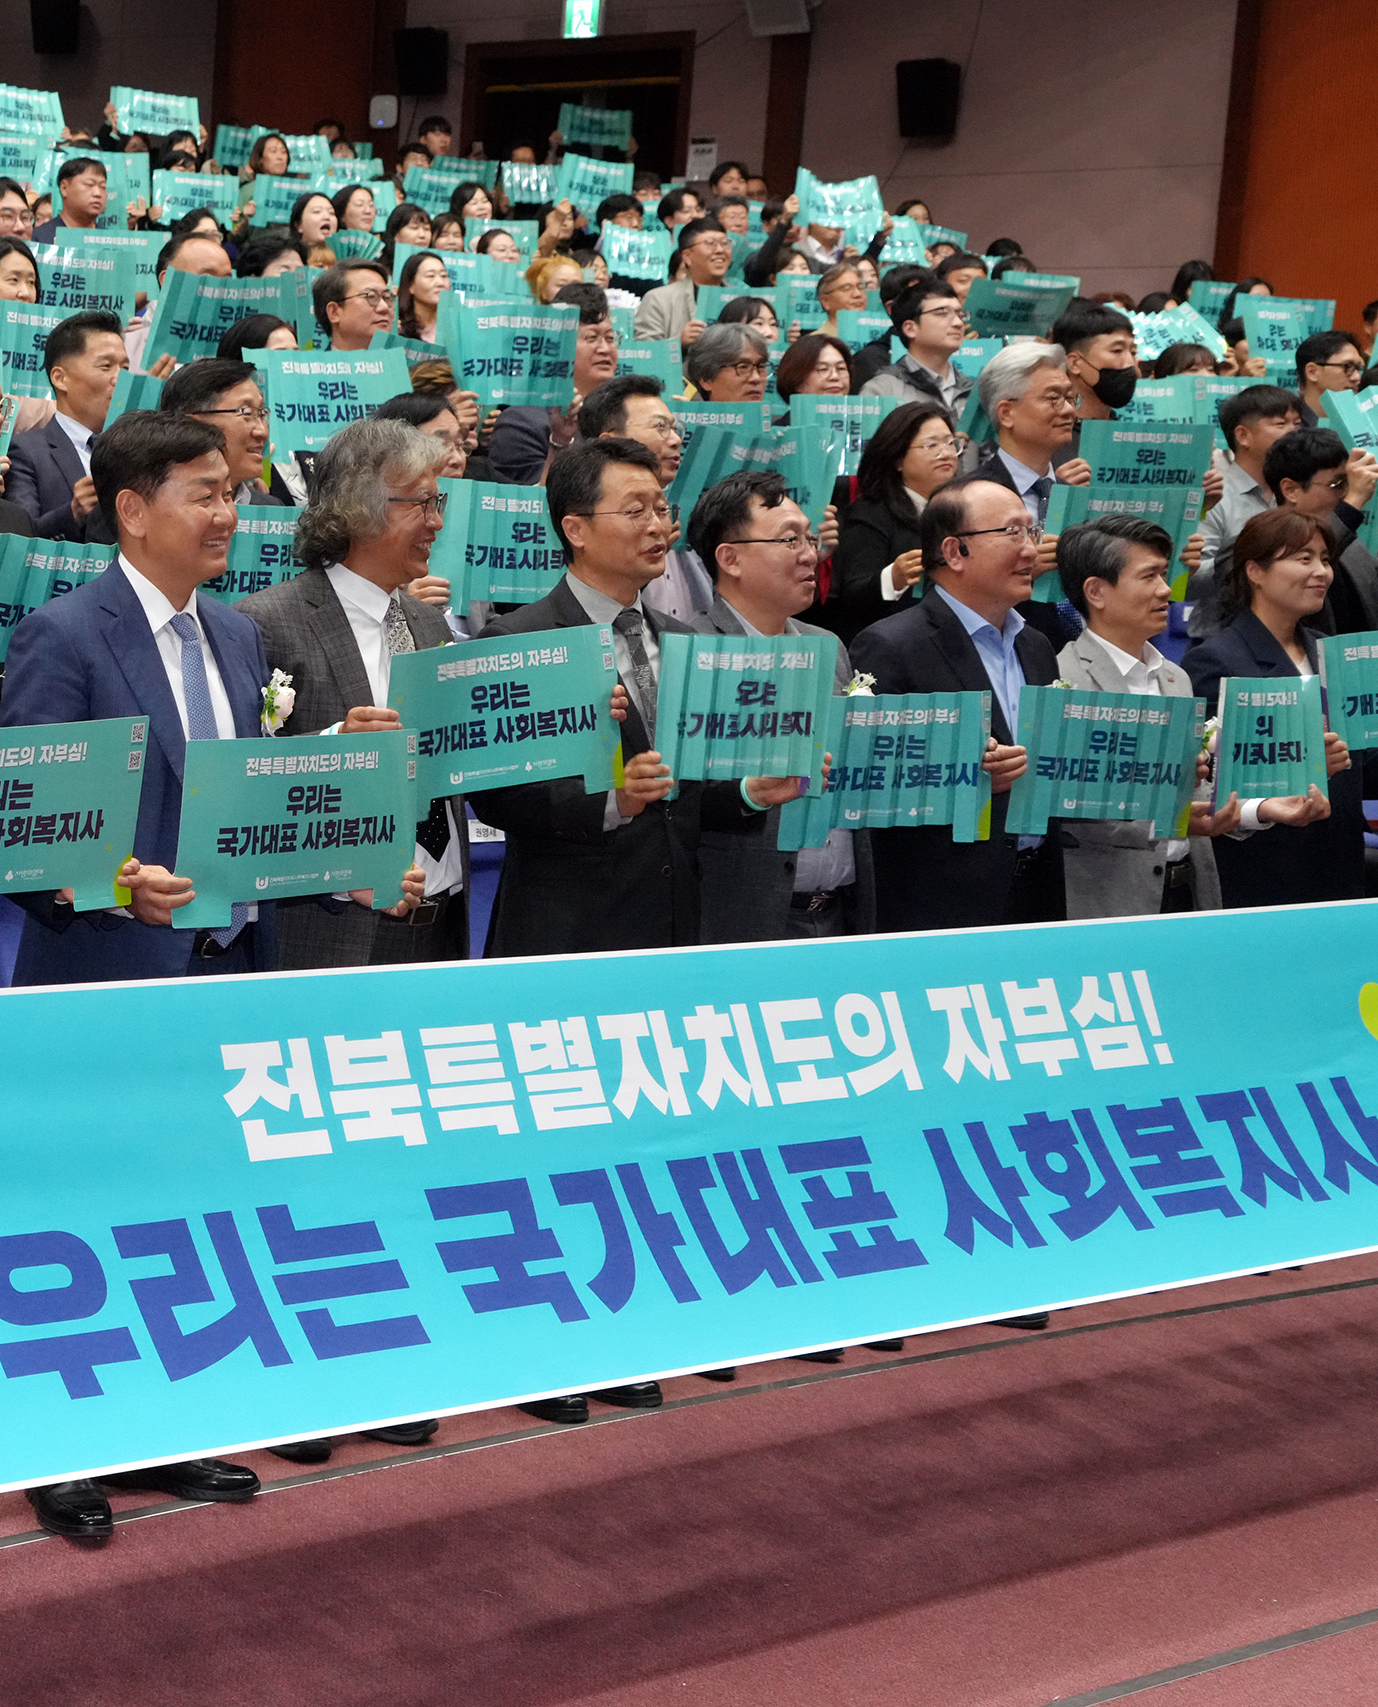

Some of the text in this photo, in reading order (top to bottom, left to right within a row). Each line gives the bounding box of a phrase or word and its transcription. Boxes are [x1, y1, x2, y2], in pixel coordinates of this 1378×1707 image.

[50, 272, 86, 290] 우리는
[59, 293, 124, 310] 사회복지사
[512, 335, 561, 357] 우리는
[463, 358, 523, 377] 국가대표
[318, 381, 358, 400] 우리는
[275, 402, 330, 423] 국가대표
[1136, 448, 1166, 465] 우리는
[437, 646, 569, 682] 전북특별자치도의 자부심!
[471, 681, 530, 714] 우리는
[418, 704, 597, 757] 국가대표 사회복지사
[1089, 730, 1137, 756] 우리는
[39, 742, 88, 765] 자부심!
[246, 751, 380, 777] 전북특별자치도의 자부심!
[286, 784, 342, 816] 우리는
[217, 815, 396, 857] 국가대표 사회복지사
[221, 969, 1174, 1162] 전북특별자치도의 자부심!
[424, 1075, 1378, 1324] 국가대표 사회복지사
